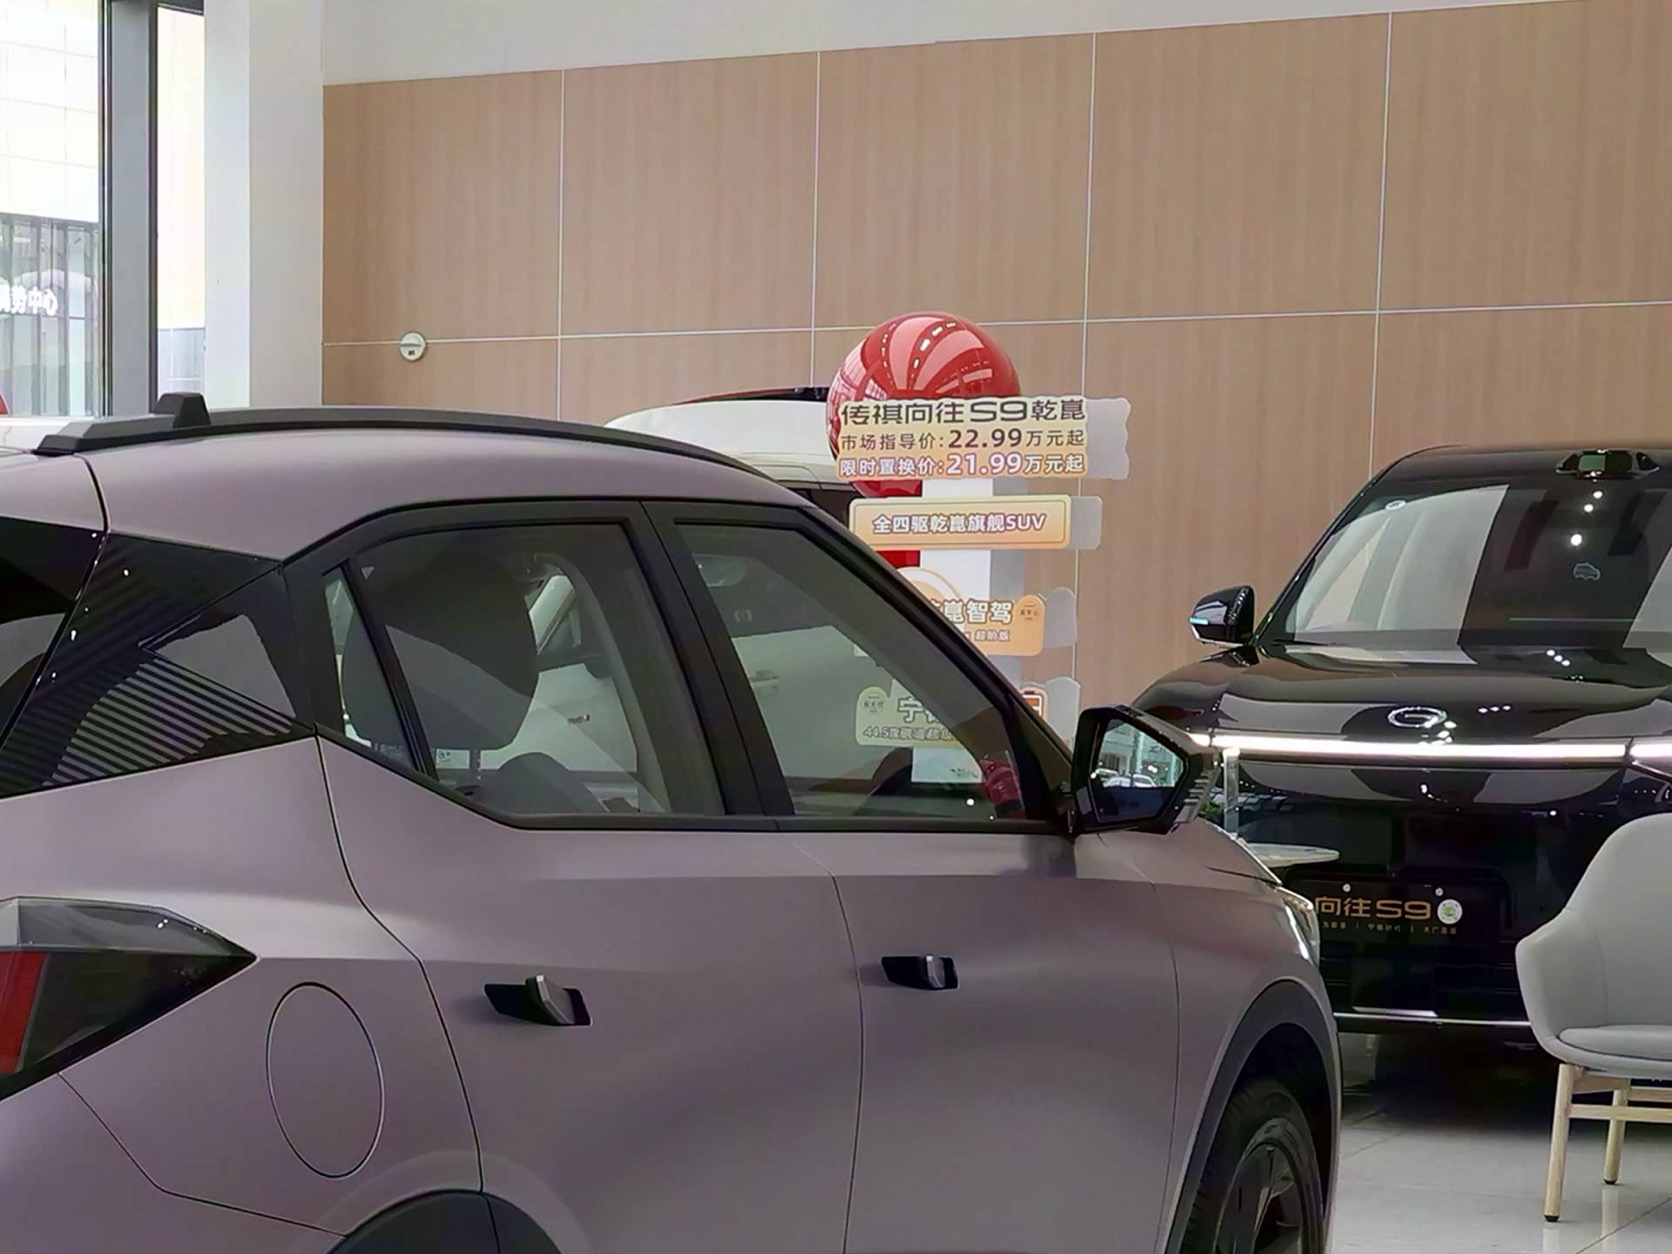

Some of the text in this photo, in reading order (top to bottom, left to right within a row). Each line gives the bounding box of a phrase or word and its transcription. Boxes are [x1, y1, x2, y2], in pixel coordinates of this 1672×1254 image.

[840, 399, 1086, 426] 传祺向往S9乾崑
[872, 513, 1047, 534] 全四驱乾崑旗舰SUV
[930, 599, 1013, 624] 崑智驾
[1314, 896, 1432, 920] 向往S9
